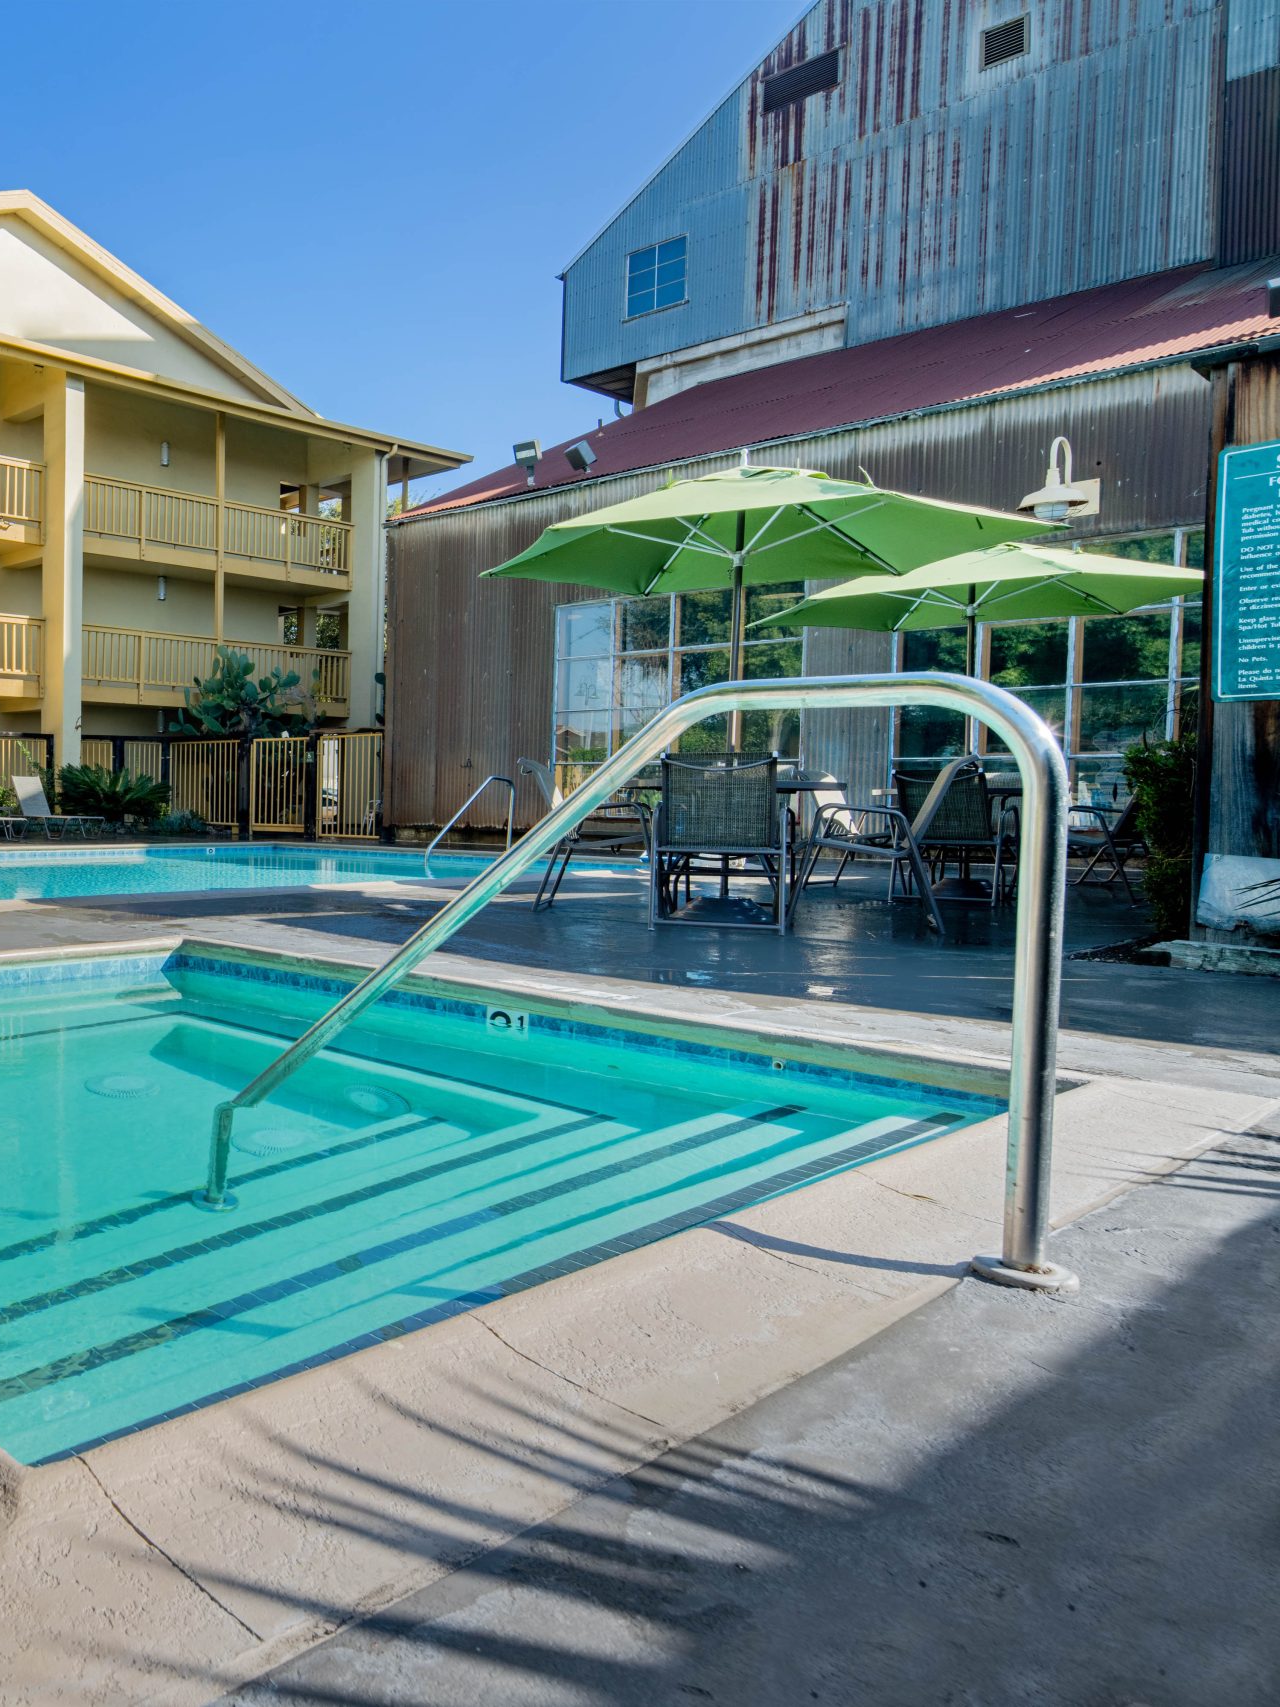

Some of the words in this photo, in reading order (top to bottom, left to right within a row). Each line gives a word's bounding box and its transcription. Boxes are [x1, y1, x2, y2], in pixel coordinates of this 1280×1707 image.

[1242, 504, 1273, 514] Pregnant
[1242, 512, 1272, 520] diabetes,
[1242, 518, 1269, 527] medical
[1241, 532, 1279, 542] permission
[1259, 615, 1276, 623] glass
[1238, 623, 1268, 632] Spa/Hot
[1249, 674, 1274, 682] Quinta
